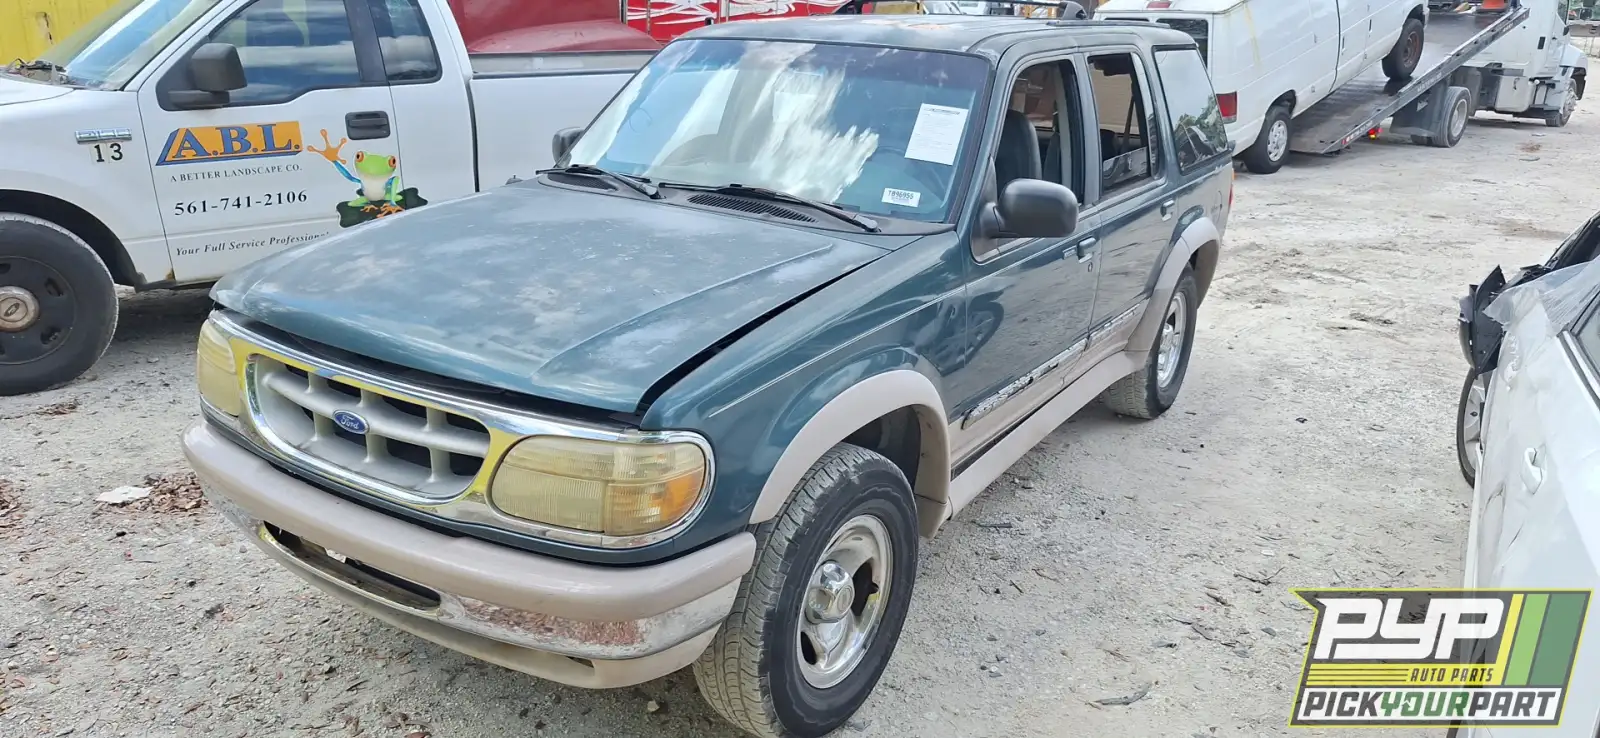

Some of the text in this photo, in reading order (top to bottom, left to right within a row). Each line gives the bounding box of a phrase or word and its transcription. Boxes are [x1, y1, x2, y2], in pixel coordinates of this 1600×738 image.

[172, 123, 300, 158] A.B.L.
[94, 142, 123, 162] 13
[171, 163, 302, 183] A BETTER LANDSCAPE CO.
[174, 189, 308, 216] 561-741-2106
[176, 247, 200, 256] Your
[204, 243, 226, 253] Full
[229, 240, 266, 251] Service
[340, 414, 360, 430] Ford
